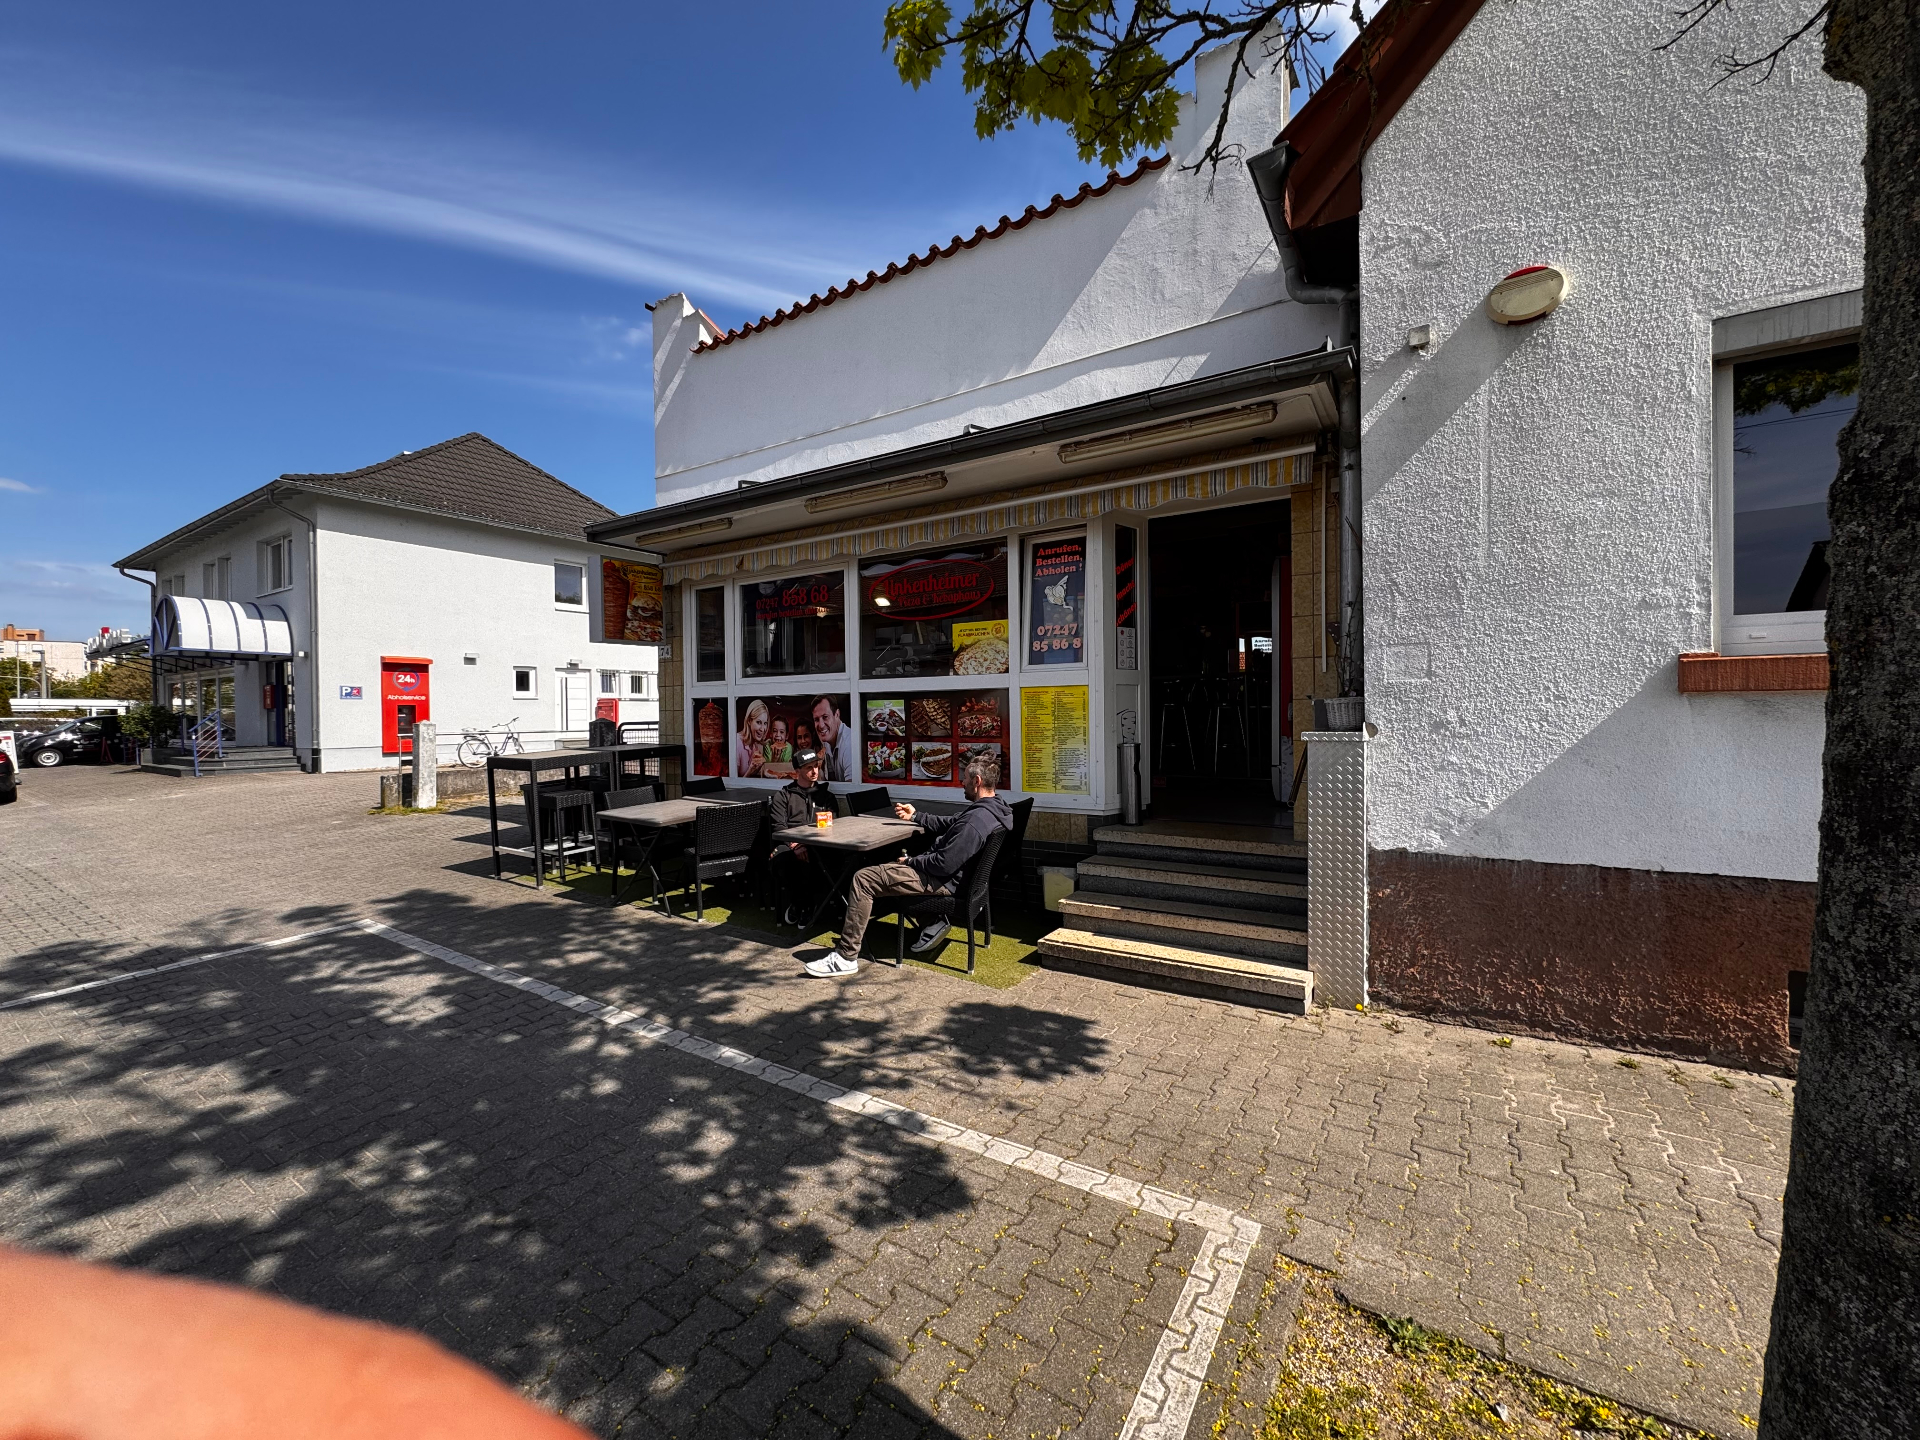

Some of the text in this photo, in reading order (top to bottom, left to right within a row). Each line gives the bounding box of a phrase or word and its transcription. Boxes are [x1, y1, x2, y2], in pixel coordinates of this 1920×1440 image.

[1037, 544, 1082, 556] Anrufen,
[1035, 554, 1083, 567] Bestellen,
[1035, 562, 1083, 577] Abholen !
[882, 572, 980, 601] Linkenheimer
[755, 584, 829, 610] 07247 858 68
[897, 596, 921, 608] Pizza
[1037, 623, 1078, 637] 07247
[1032, 637, 1082, 653] 85 86 8
[660, 647, 670, 657] 74
[397, 674, 415, 683] 24h
[342, 686, 351, 696] P
